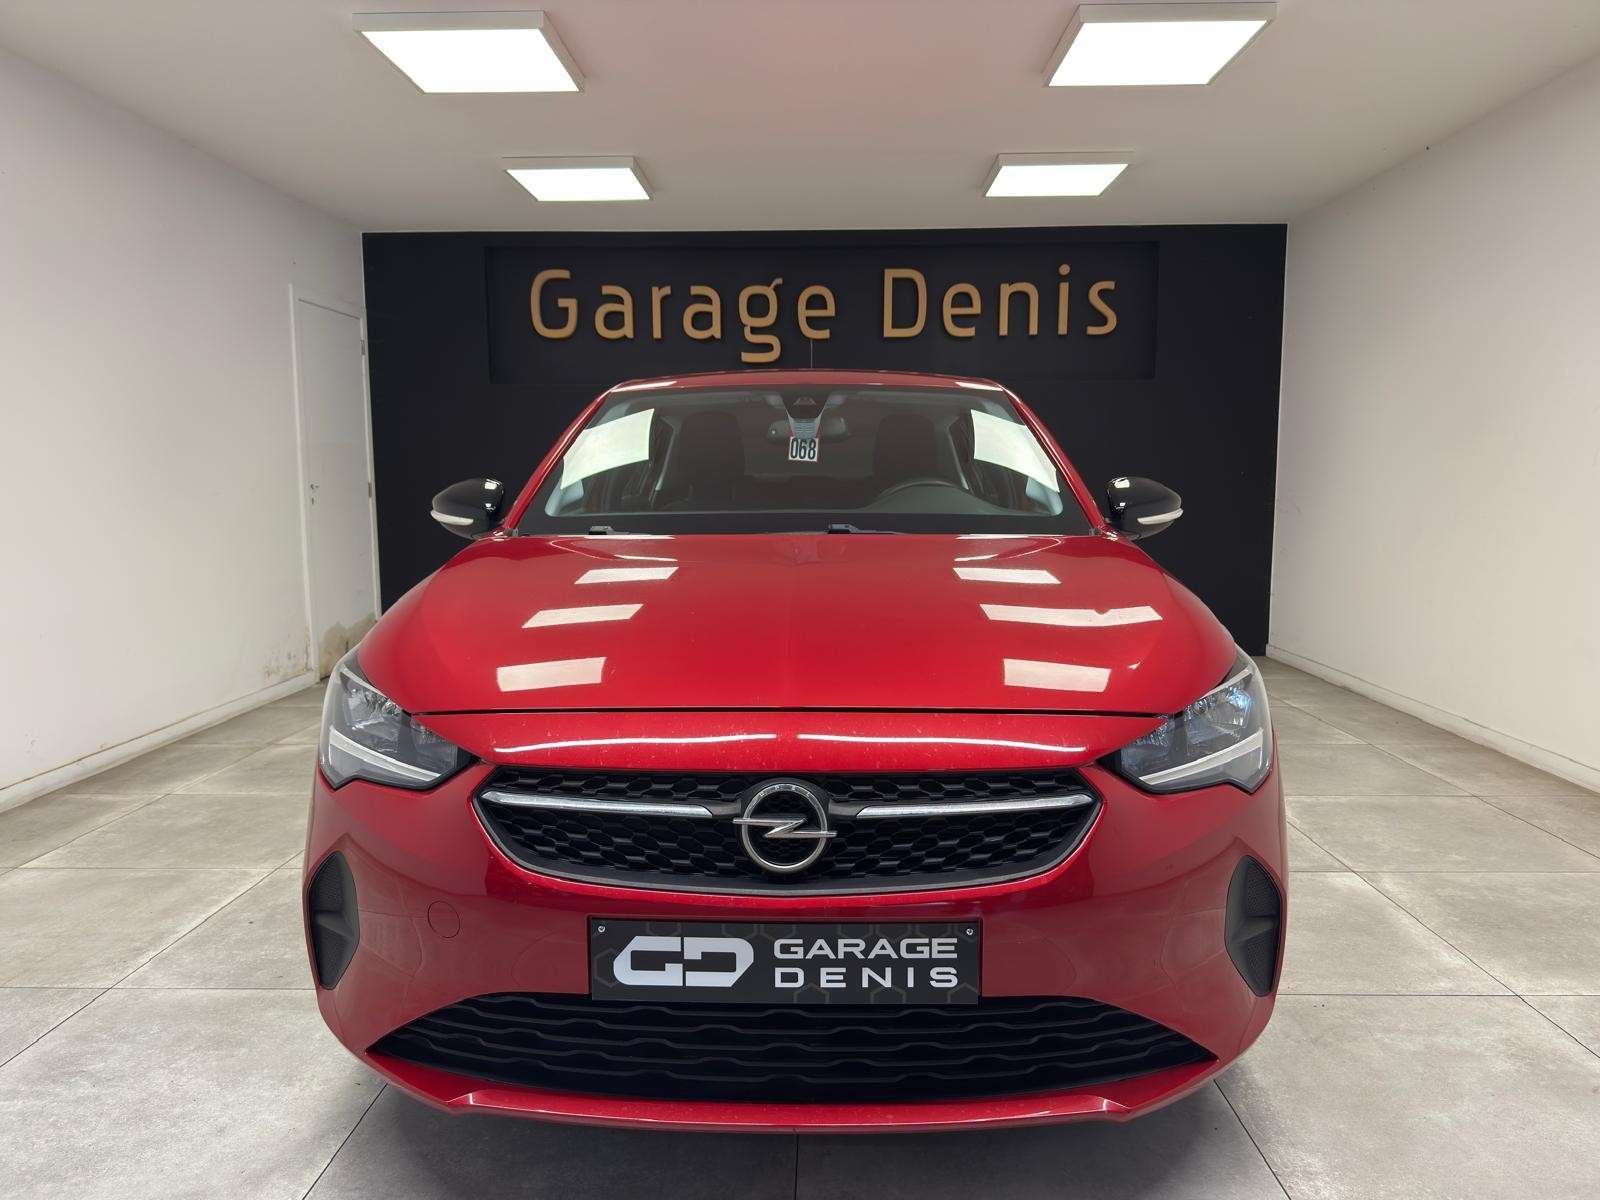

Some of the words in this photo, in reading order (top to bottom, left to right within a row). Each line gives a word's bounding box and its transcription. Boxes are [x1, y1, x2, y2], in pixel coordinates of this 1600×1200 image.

[530, 268, 836, 364] Garage
[882, 264, 1119, 338] Denis
[790, 438, 817, 460] 068
[773, 937, 958, 960] GARAGE
[774, 966, 959, 989] DENIS
